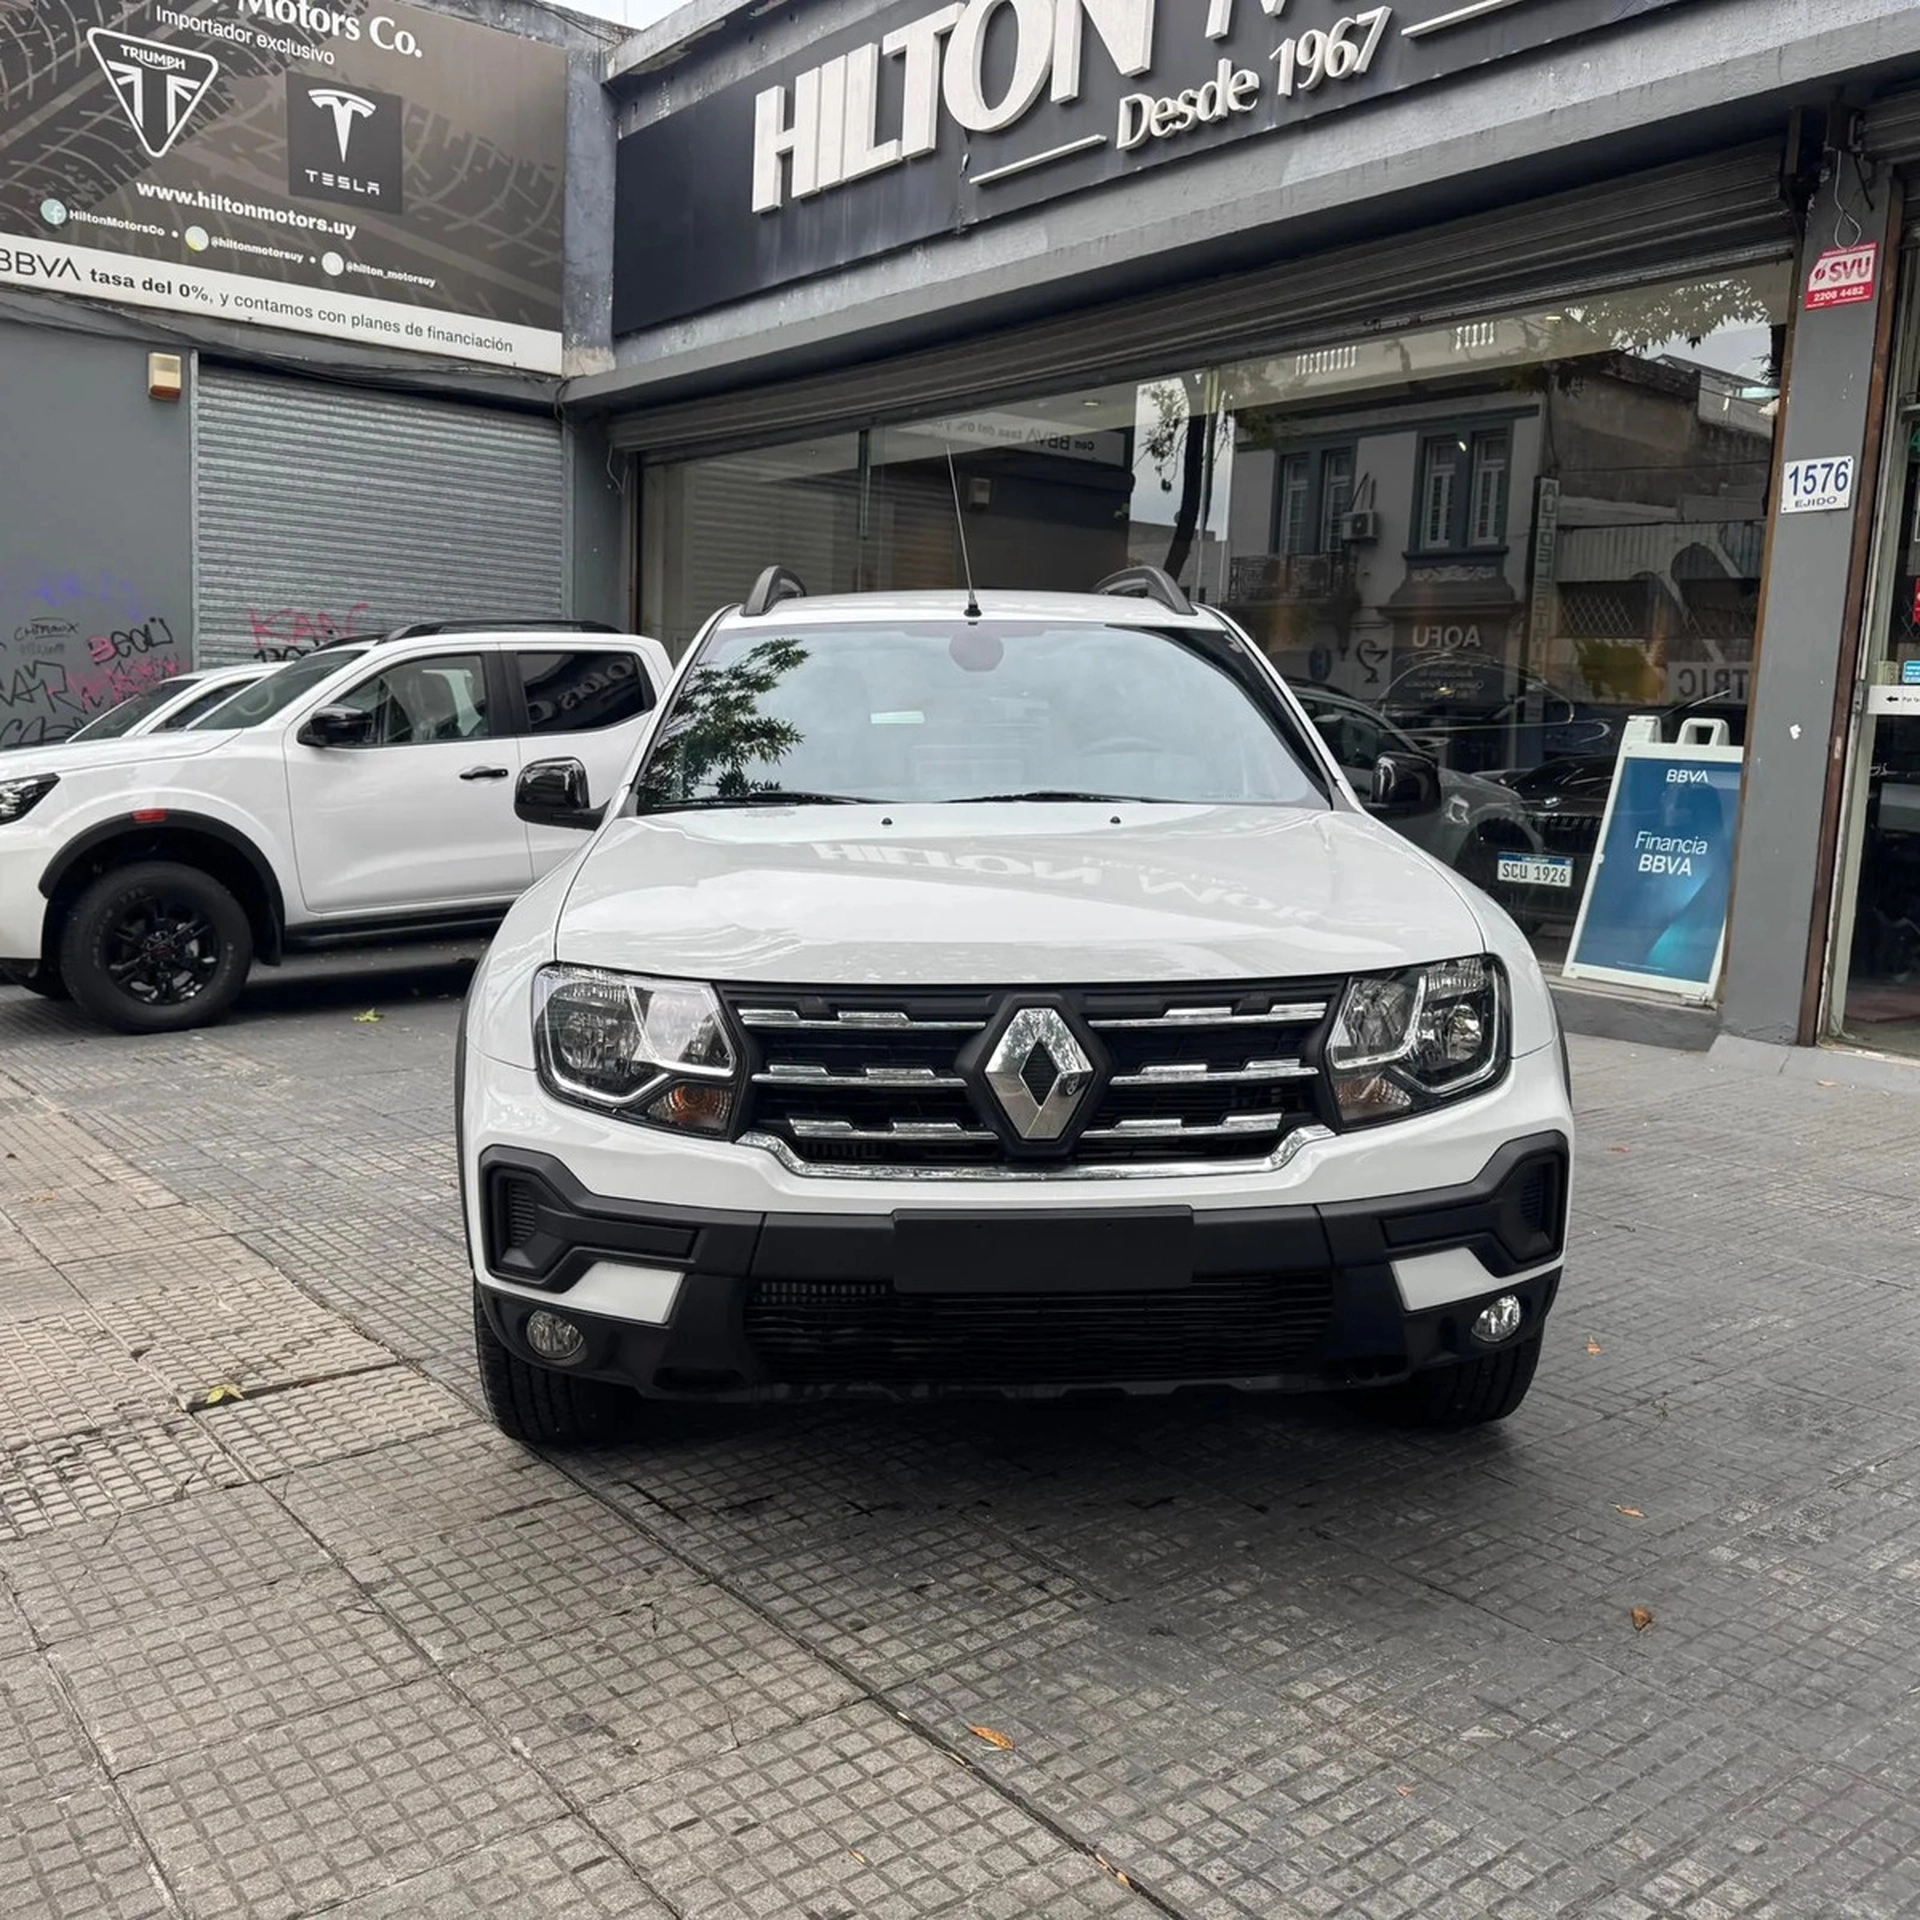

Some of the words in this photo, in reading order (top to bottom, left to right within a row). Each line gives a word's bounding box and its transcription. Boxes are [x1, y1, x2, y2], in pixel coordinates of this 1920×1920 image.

[156, 5, 252, 45] Importador
[256, 34, 335, 65] exclusivo
[369, 16, 423, 58] Co.
[120, 44, 185, 71] TRIUMPH
[1116, 57, 1260, 150] Desde
[1268, 5, 1393, 97] 1967
[752, 0, 1154, 213] HILTON
[305, 169, 380, 195] TESLA
[136, 182, 357, 240] www.hiltonmotors.uy
[69, 210, 166, 236] HiltonMotorsCo
[211, 235, 304, 263] @hiltonmotorsuy
[346, 261, 436, 288] @hilton_motorsuy
[1829, 256, 1871, 282] SVU
[0, 248, 81, 281] BBVA
[90, 268, 135, 289] tasa
[142, 277, 172, 295] del
[179, 283, 214, 304] 0%,
[220, 293, 229, 307] y
[234, 295, 314, 319] contamos
[317, 308, 346, 324] con
[351, 314, 401, 334] planes
[405, 321, 424, 337] de
[428, 326, 513, 353] financiación
[1789, 460, 1849, 497] 1576
[1794, 495, 1837, 508] EJIDO
[1666, 768, 1709, 783] BBVA
[1634, 831, 1708, 855] Financia
[1501, 862, 1528, 880] SCU
[1534, 865, 1567, 884] 1926
[1638, 853, 1692, 876] BBVA
